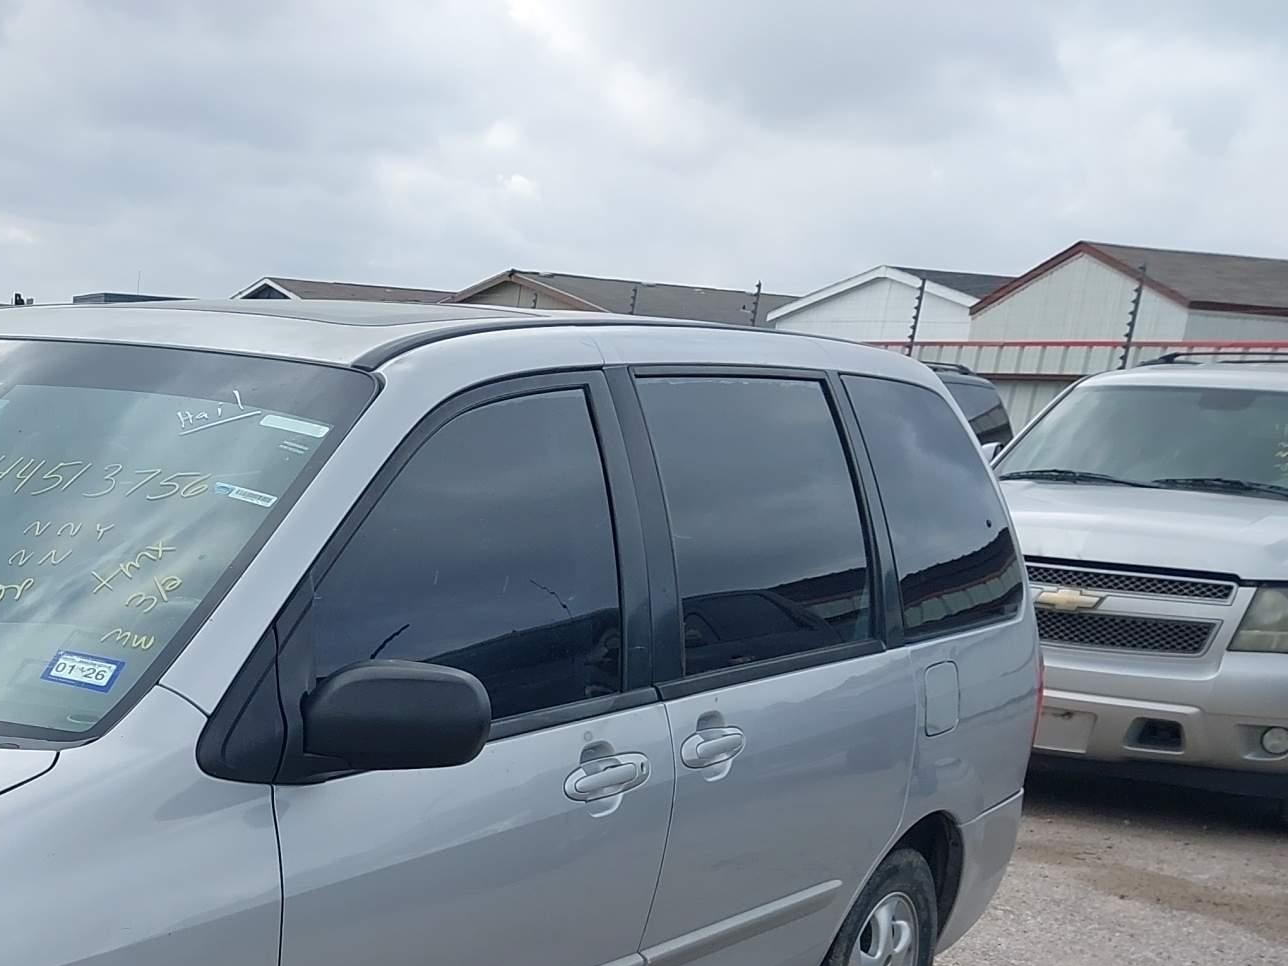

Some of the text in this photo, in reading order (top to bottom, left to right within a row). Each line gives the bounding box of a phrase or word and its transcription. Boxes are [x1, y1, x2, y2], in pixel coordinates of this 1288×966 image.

[176, 389, 245, 429] Hail
[55, 662, 76, 675] 01
[83, 667, 108, 681] 26
